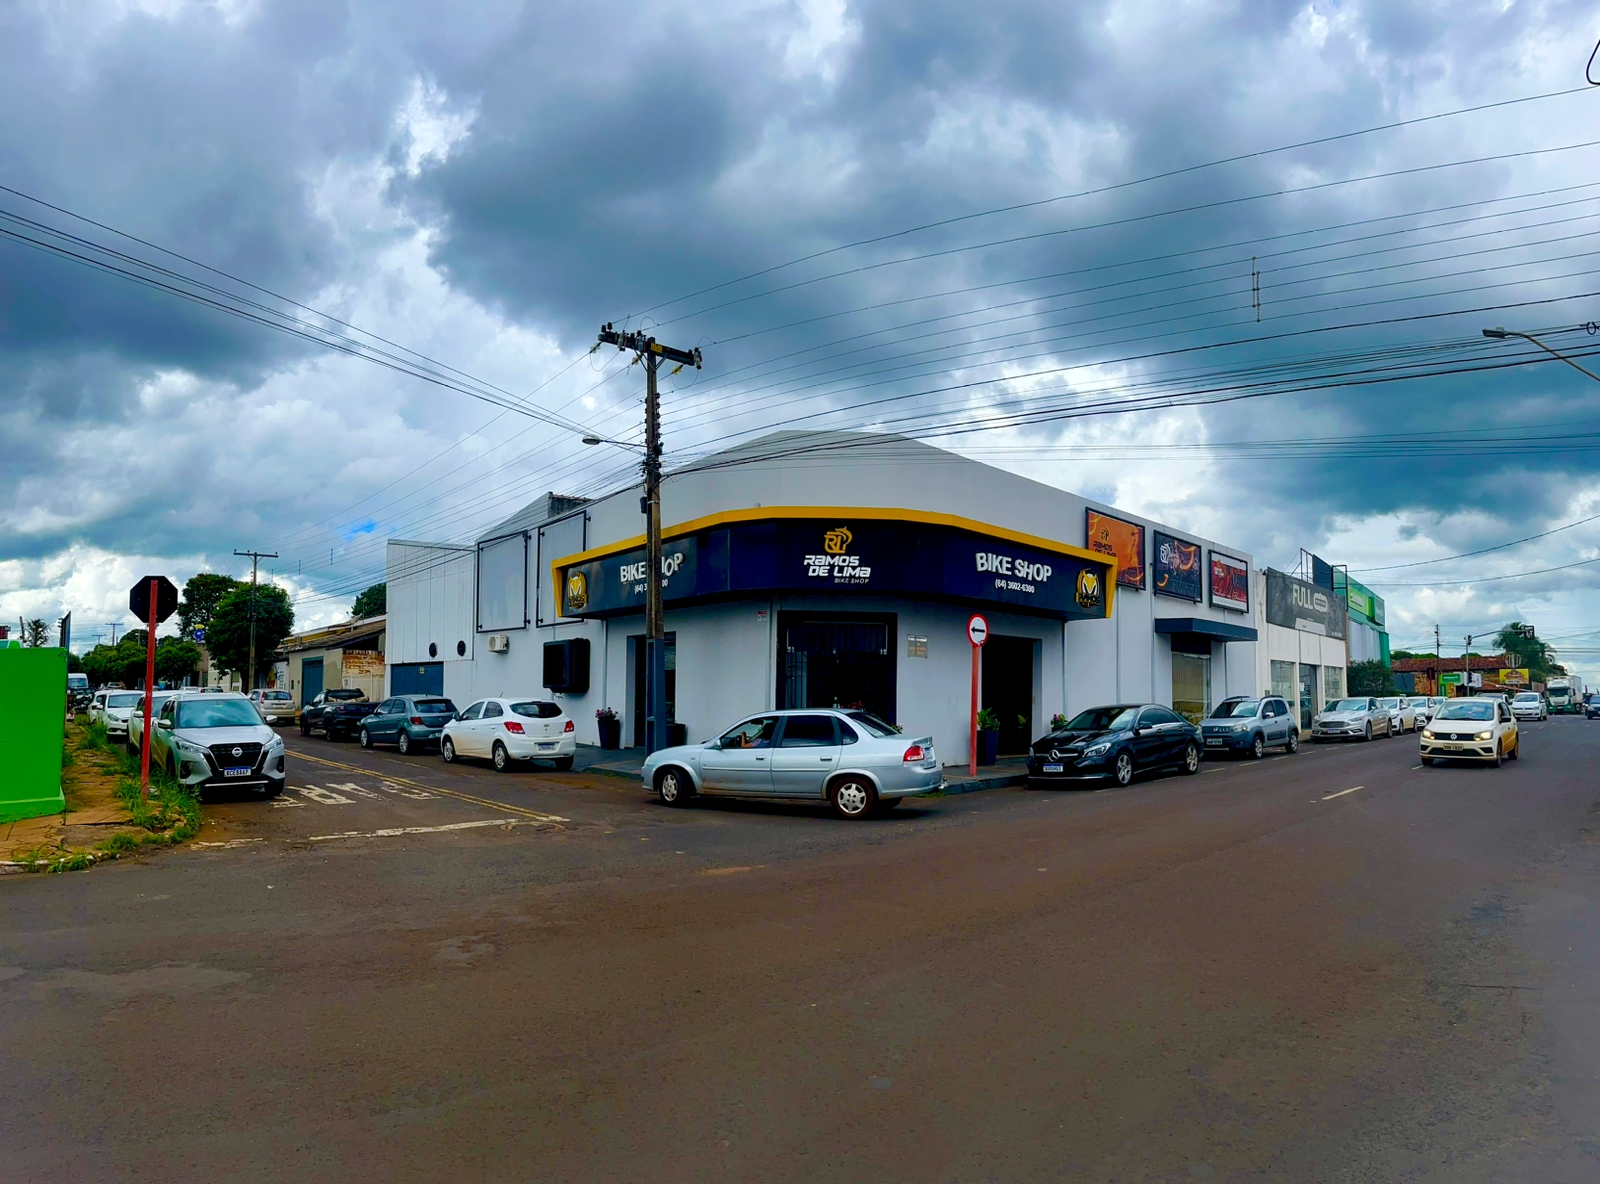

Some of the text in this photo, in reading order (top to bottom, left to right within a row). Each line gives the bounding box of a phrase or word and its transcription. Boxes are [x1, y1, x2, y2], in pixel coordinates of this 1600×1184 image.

[620, 561, 647, 583] BIKE
[808, 566, 830, 576] DE
[975, 552, 1052, 582] BIKE SHOP
[995, 578, 1035, 593] (64) 3602-6300
[1292, 583, 1314, 610] FULL
